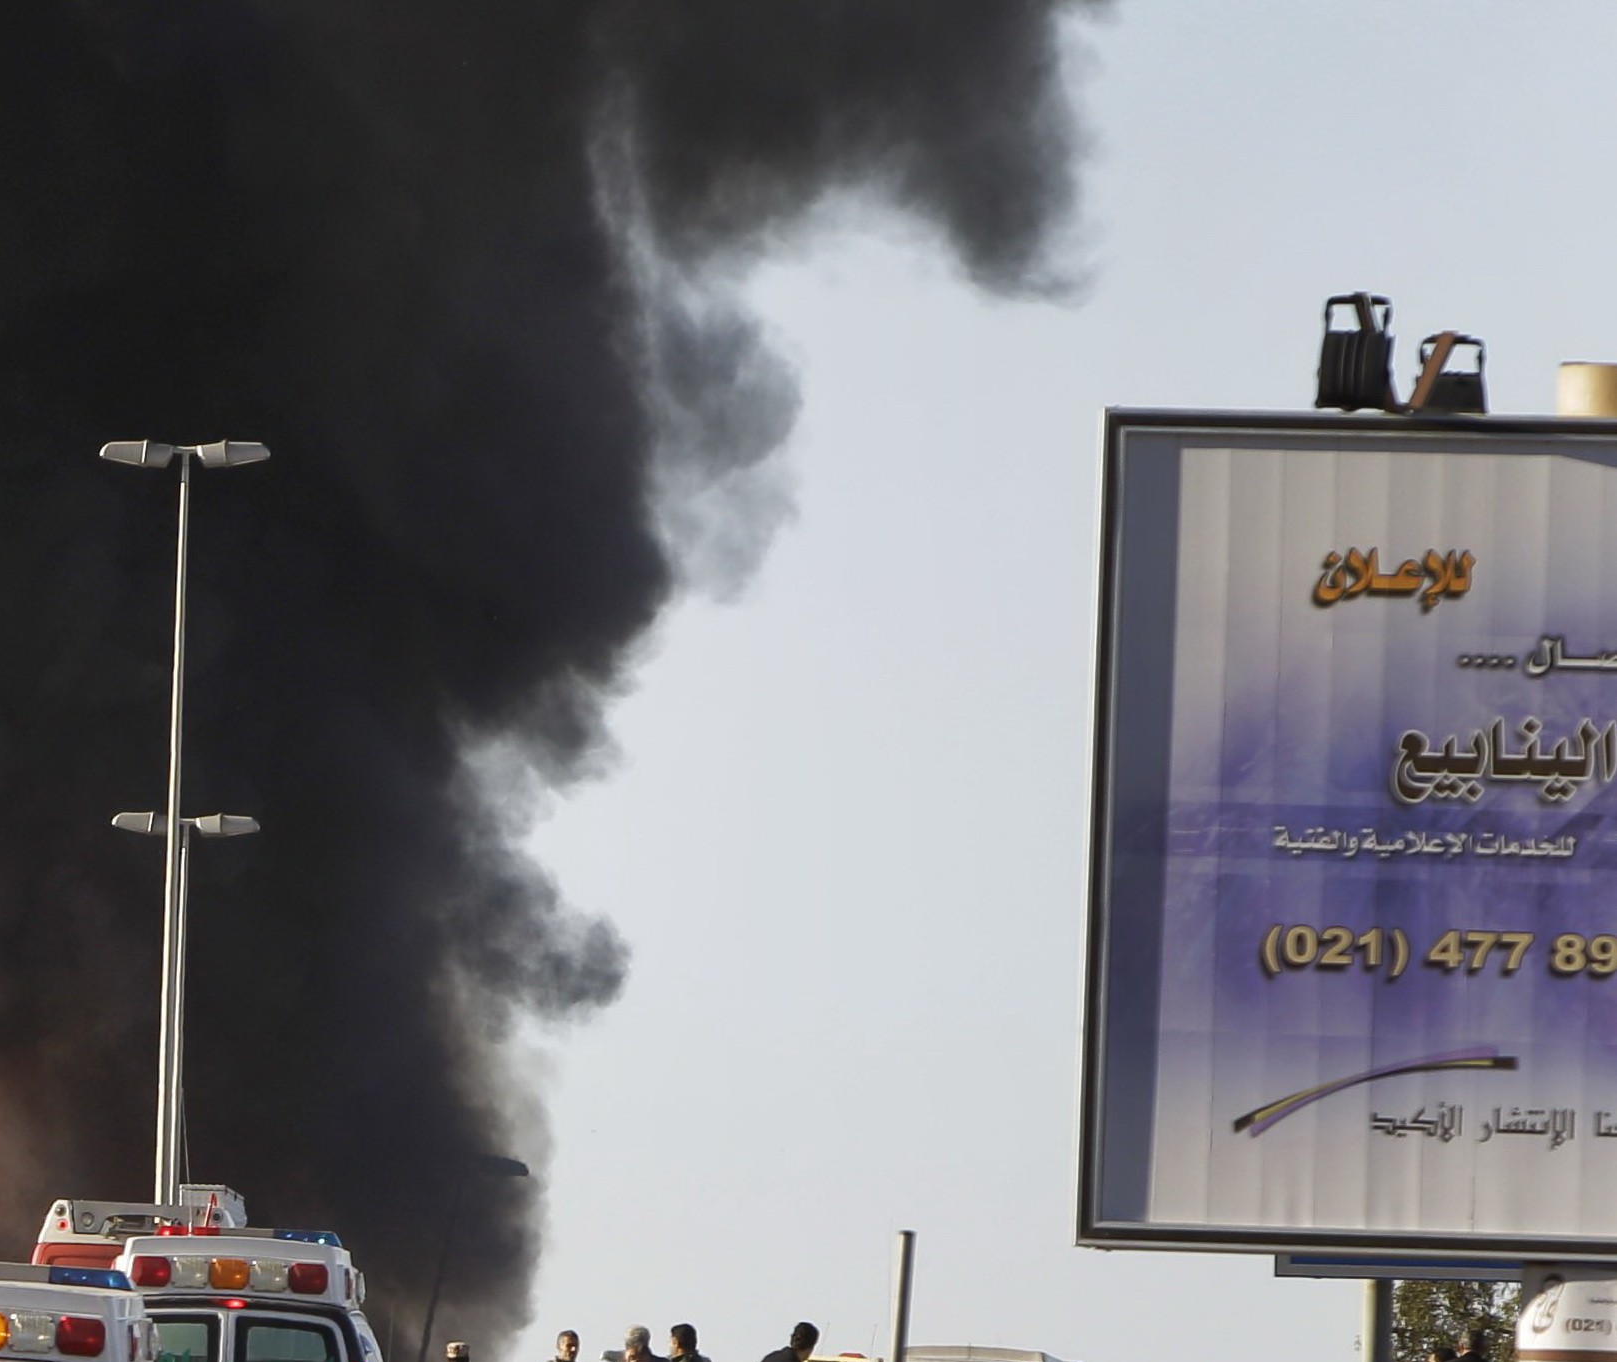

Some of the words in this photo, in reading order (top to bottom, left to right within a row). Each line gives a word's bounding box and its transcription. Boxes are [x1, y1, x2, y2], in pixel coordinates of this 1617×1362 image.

[1314, 546, 1476, 608] للإعلان
[1263, 925, 1410, 976] (021)
[1427, 929, 1535, 970] 477
[1566, 1318, 1613, 1336] (021)
